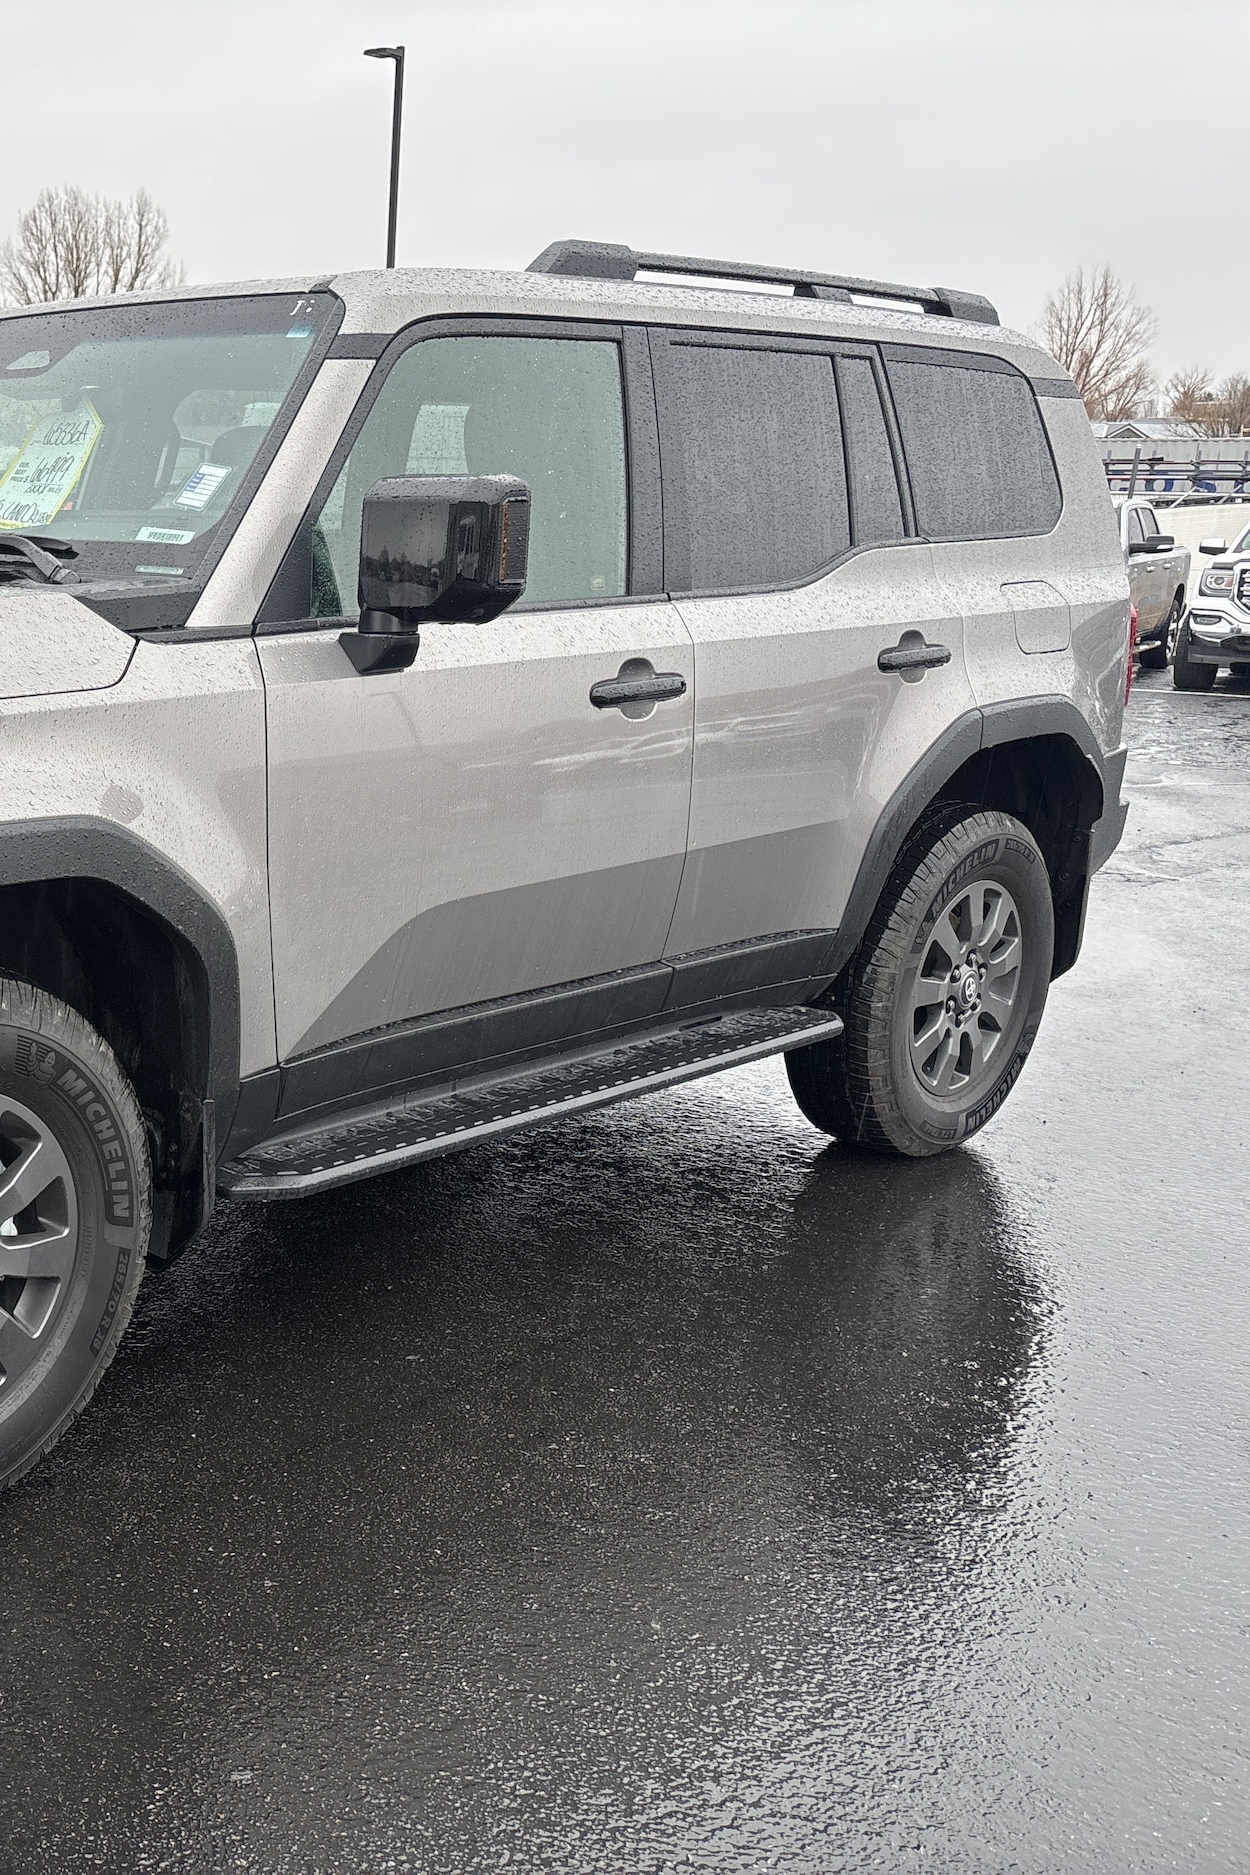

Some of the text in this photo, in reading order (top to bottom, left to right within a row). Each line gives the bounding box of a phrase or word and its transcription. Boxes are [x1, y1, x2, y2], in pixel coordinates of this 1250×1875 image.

[931, 841, 998, 919] MICHELIN
[965, 1057, 1022, 1132] MICHELIN
[56, 1068, 130, 1218] MICHELIN
[107, 1252, 129, 1313] 265/70
